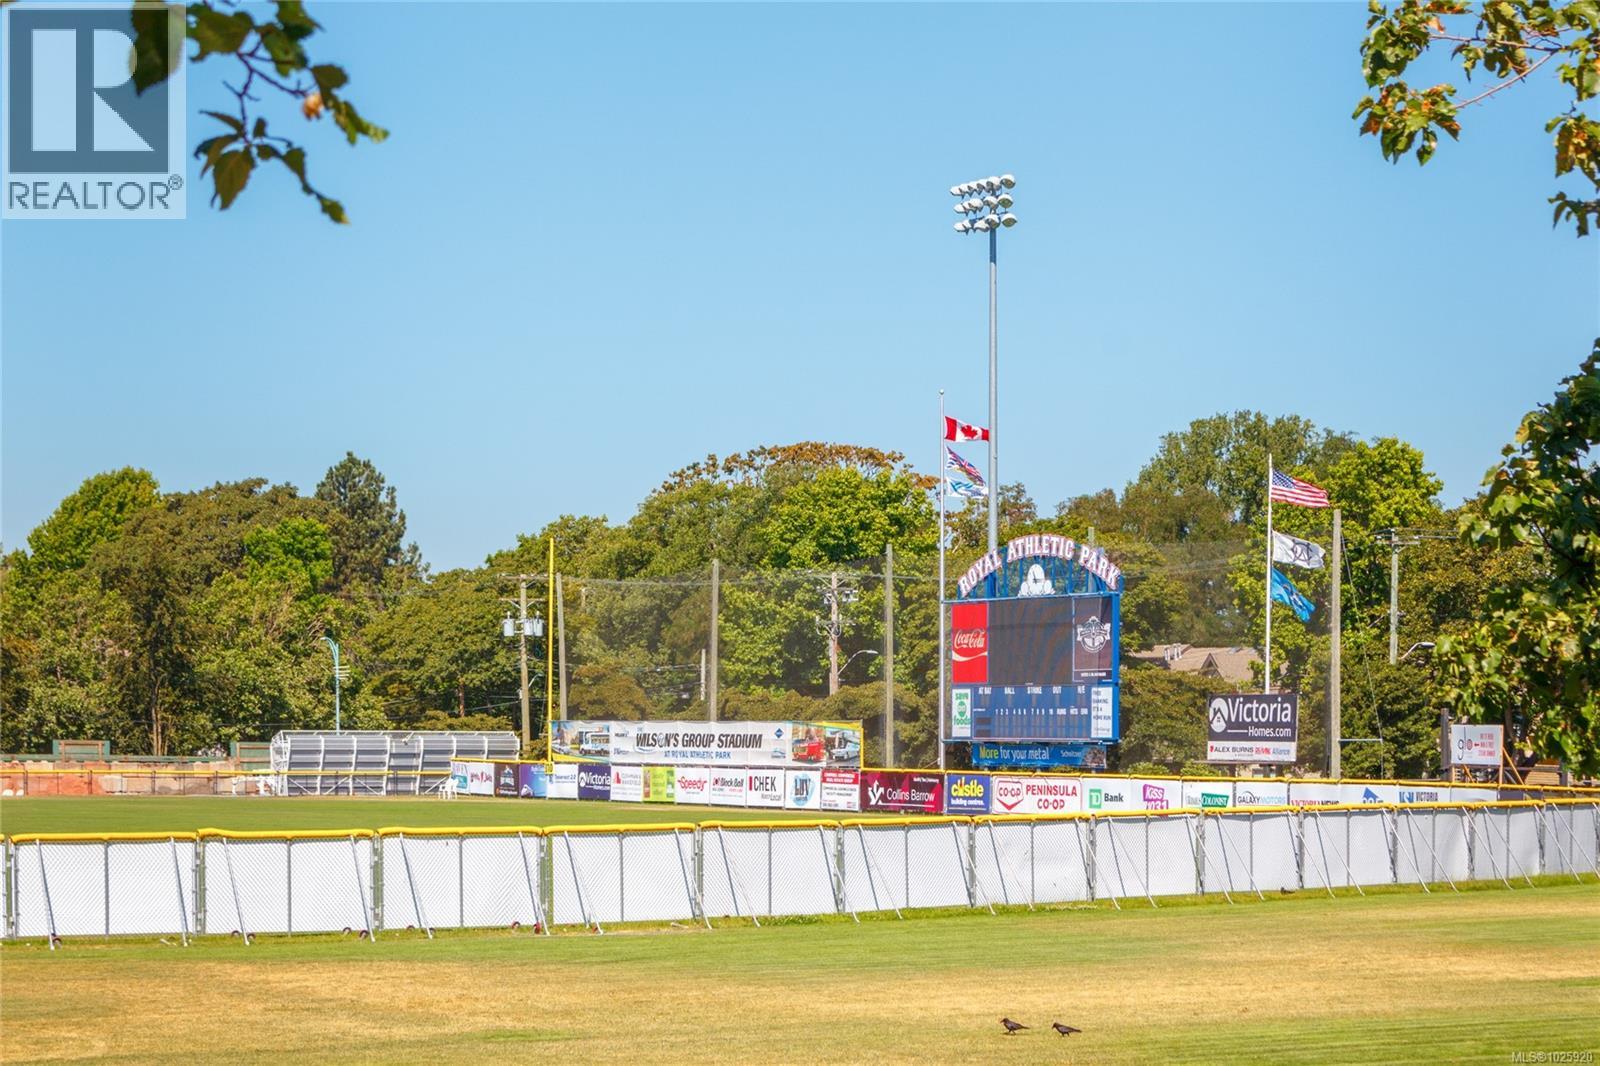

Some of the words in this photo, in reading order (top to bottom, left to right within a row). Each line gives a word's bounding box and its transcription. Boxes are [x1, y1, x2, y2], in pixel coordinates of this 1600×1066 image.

[957, 549, 1002, 598] ROYAL
[1006, 534, 1075, 563] ATHLETIC
[1078, 544, 1121, 591] PARK
[954, 629, 985, 650] Coca-Cola
[1004, 686, 1016, 694] BALL
[1027, 686, 1042, 694] STRIKE
[1052, 686, 1062, 694] OUT
[1227, 697, 1291, 722] Victoria
[1248, 725, 1292, 737] Homes.com
[635, 732, 679, 748] WILSON'S
[681, 732, 714, 748] GROUP
[717, 733, 763, 748] STADIUM
[664, 750, 670, 758] AT
[670, 750, 689, 759] ROYAL
[689, 751, 713, 759] ATHLETIC
[715, 751, 731, 759] PARK
[979, 746, 998, 759] More
[999, 746, 1010, 759] for
[1010, 748, 1027, 762] your
[1027, 747, 1050, 761] metal
[586, 771, 611, 785] Victoria
[678, 776, 708, 791] Speedy
[720, 777, 733, 787] Black
[753, 776, 777, 792] CHEK
[951, 776, 984, 797] castle
[998, 787, 1021, 797] CO-OP
[1025, 784, 1078, 797] PENINSULA
[886, 788, 909, 801] Collins
[910, 789, 935, 802] Barrow
[1103, 792, 1124, 802] Bank
[1202, 795, 1228, 806] COLONIST
[1237, 795, 1260, 804] GALAXY
[1415, 791, 1438, 802] VICTORIA
[1037, 798, 1065, 810] CO-OP
